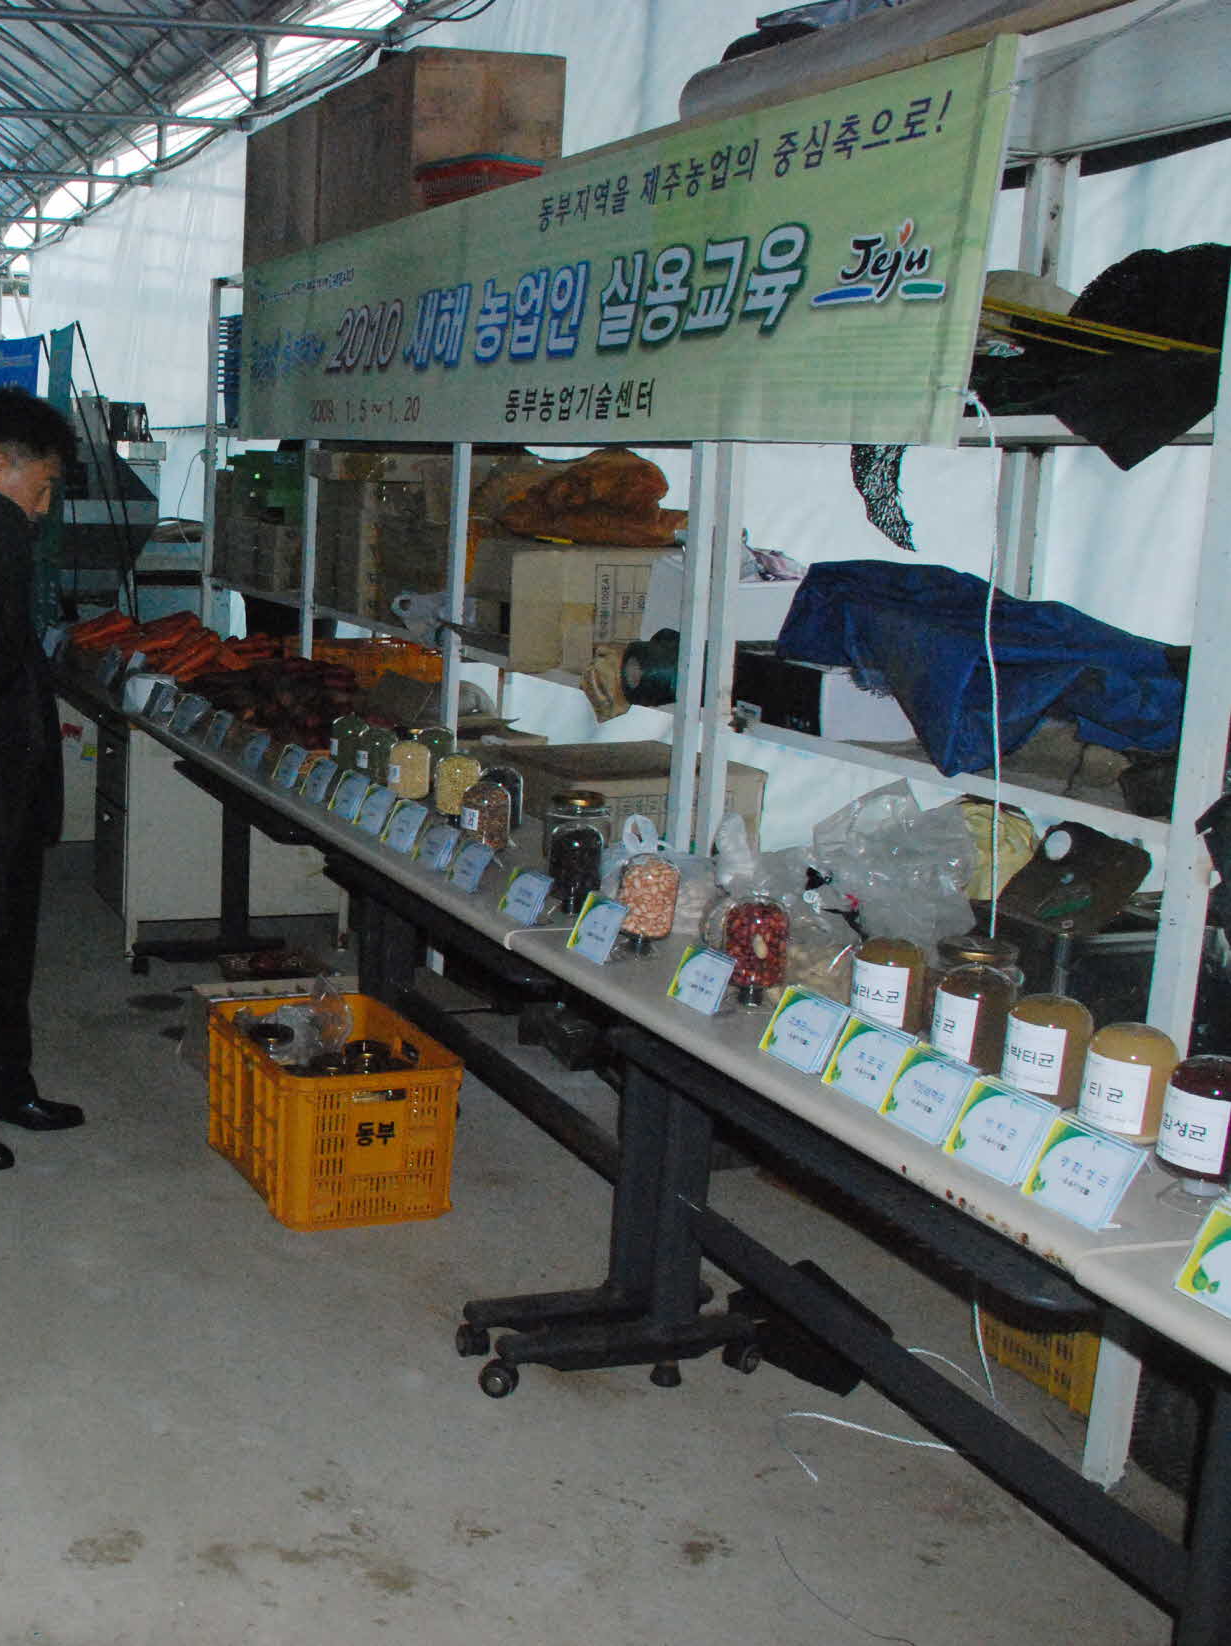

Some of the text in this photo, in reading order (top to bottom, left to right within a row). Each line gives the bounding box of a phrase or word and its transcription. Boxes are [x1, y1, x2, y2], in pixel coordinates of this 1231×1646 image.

[537, 90, 954, 232] 동부지역을 제주농업의 중심축으로!
[326, 298, 404, 374] 2010
[404, 282, 473, 371] 새해
[474, 260, 590, 363] 농업인
[596, 222, 809, 354] 실용교육
[837, 218, 931, 303] Jeju
[505, 378, 656, 423] 동부농업기술센터
